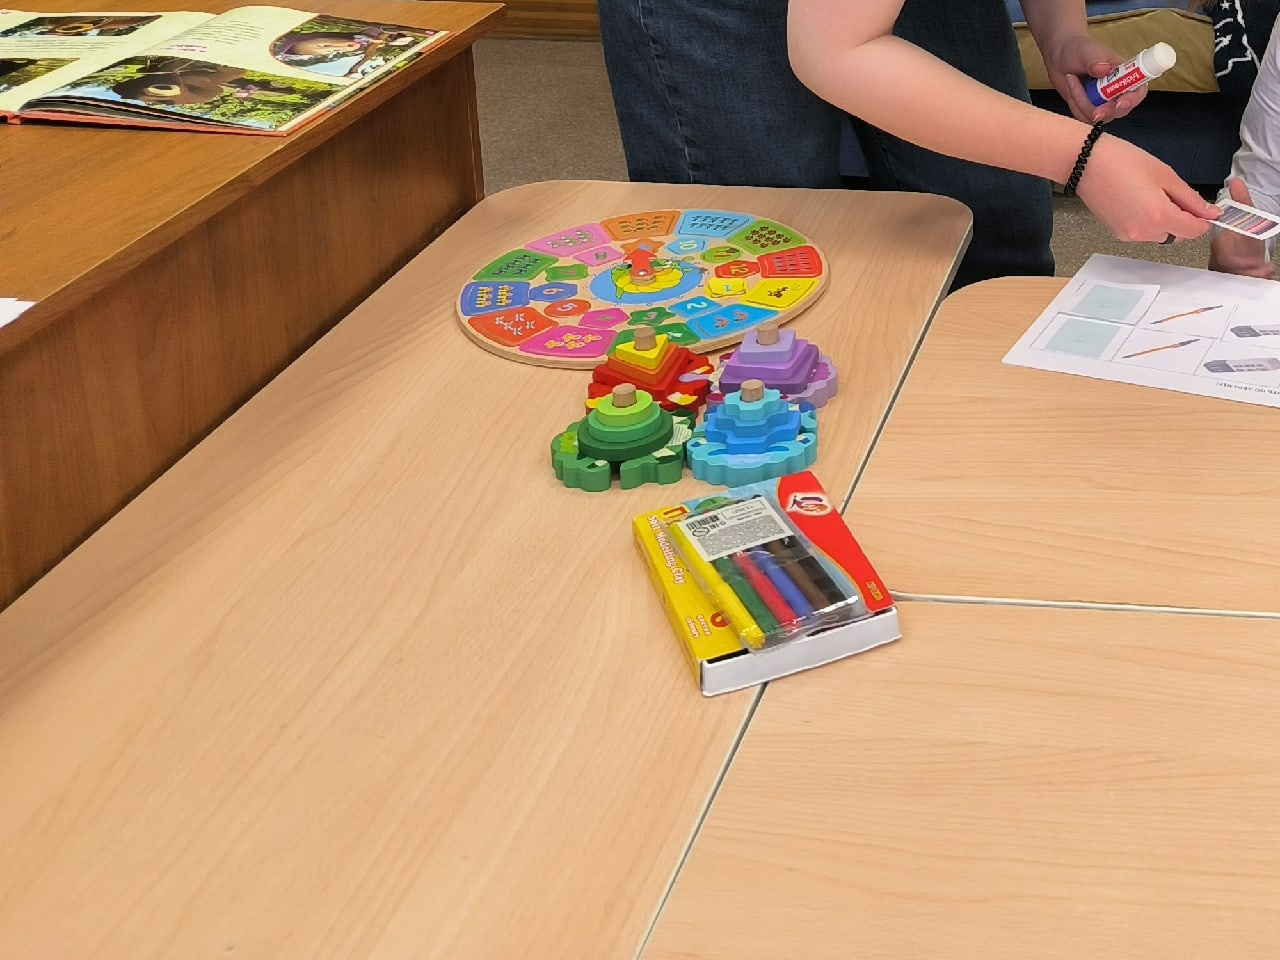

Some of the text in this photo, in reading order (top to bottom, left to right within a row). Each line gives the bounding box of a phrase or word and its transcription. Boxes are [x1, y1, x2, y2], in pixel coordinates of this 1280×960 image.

[680, 240, 698, 250] 10
[729, 263, 749, 275] 12
[542, 287, 565, 295] 6
[556, 302, 579, 312] 5
[686, 301, 708, 310] 2
[655, 531, 678, 568] Modelling
[671, 567, 687, 585] Clay
